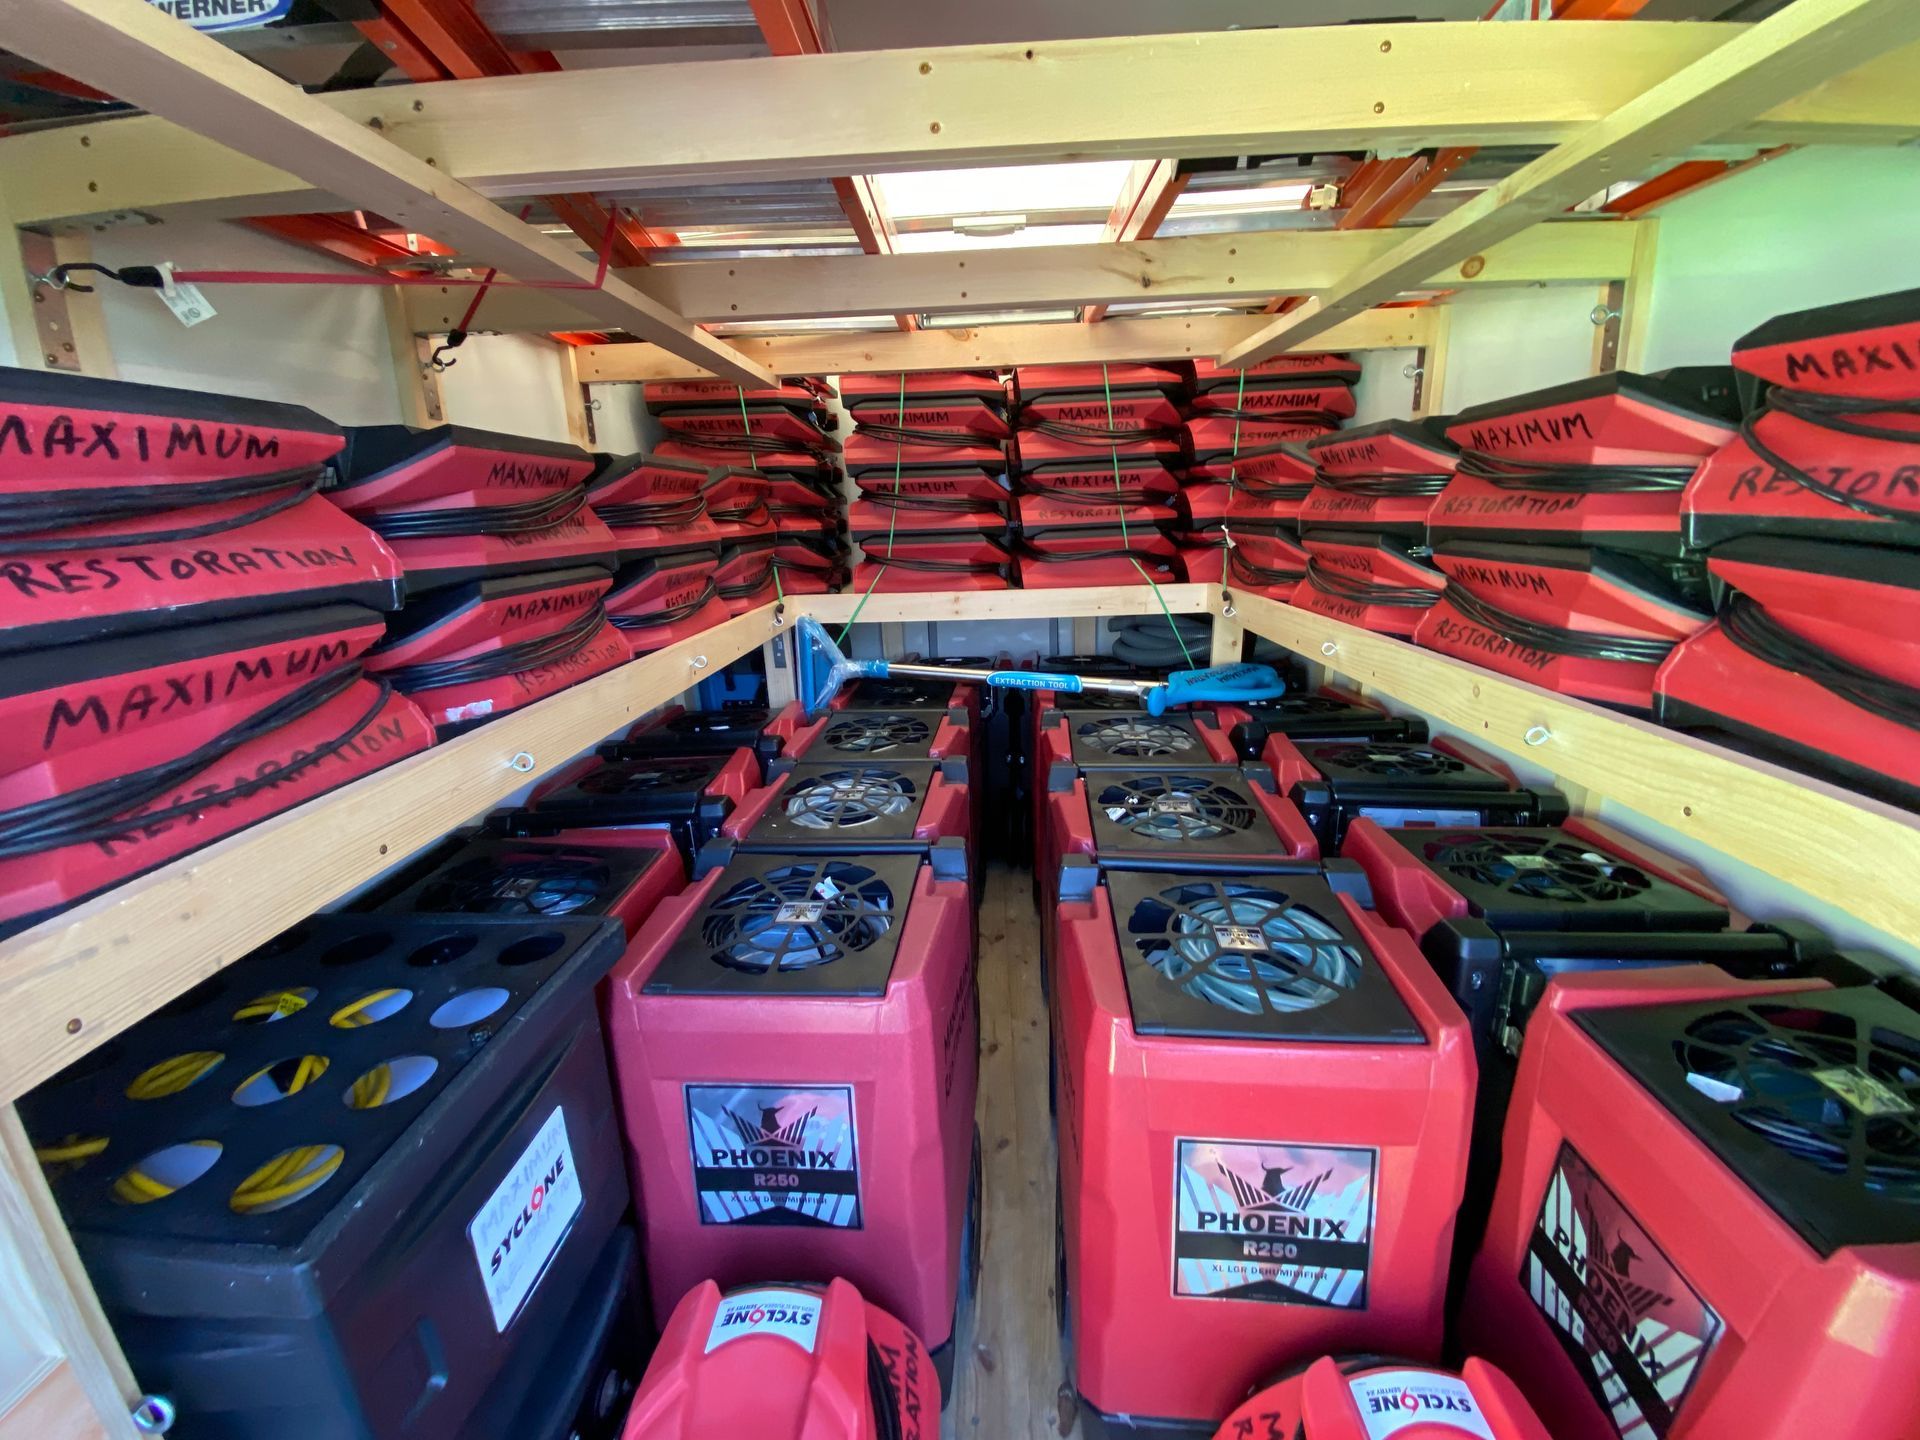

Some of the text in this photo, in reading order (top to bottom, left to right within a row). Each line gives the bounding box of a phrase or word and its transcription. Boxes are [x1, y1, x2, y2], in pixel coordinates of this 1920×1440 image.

[1785, 341, 1920, 382] MAXI
[1058, 404, 1135, 420] MAXIMUM
[1242, 393, 1321, 408] MAXIMUM
[879, 411, 949, 425] MAXIMUM
[1470, 412, 1593, 451] MAXIMUM
[487, 461, 570, 488] MAXIMUM
[876, 480, 957, 493] MAXIMUM
[1053, 474, 1141, 487] MAXIMUM
[1443, 493, 1586, 516] RESTORATION
[2, 545, 357, 599] RESTORATION
[1452, 562, 1554, 597] MAXIMUM
[500, 587, 601, 626] MAXIMUM
[1434, 617, 1557, 670] RESTORATION
[514, 640, 621, 694] RESTORATION
[42, 639, 350, 751] MAXIMUM
[995, 677, 1069, 689] EXTRACTION TOOL
[711, 1148, 837, 1168] PHOENIX
[754, 1173, 800, 1187] R250
[491, 1151, 565, 1276] SYCLONE
[1197, 1211, 1347, 1239] PHOENIX
[1242, 1240, 1298, 1259] R250
[1212, 1264, 1225, 1273] XL
[721, 1308, 813, 1327] SYCLONE
[1553, 1225, 1665, 1385] PHOENIX
[1368, 1390, 1472, 1415] SYCLONE
